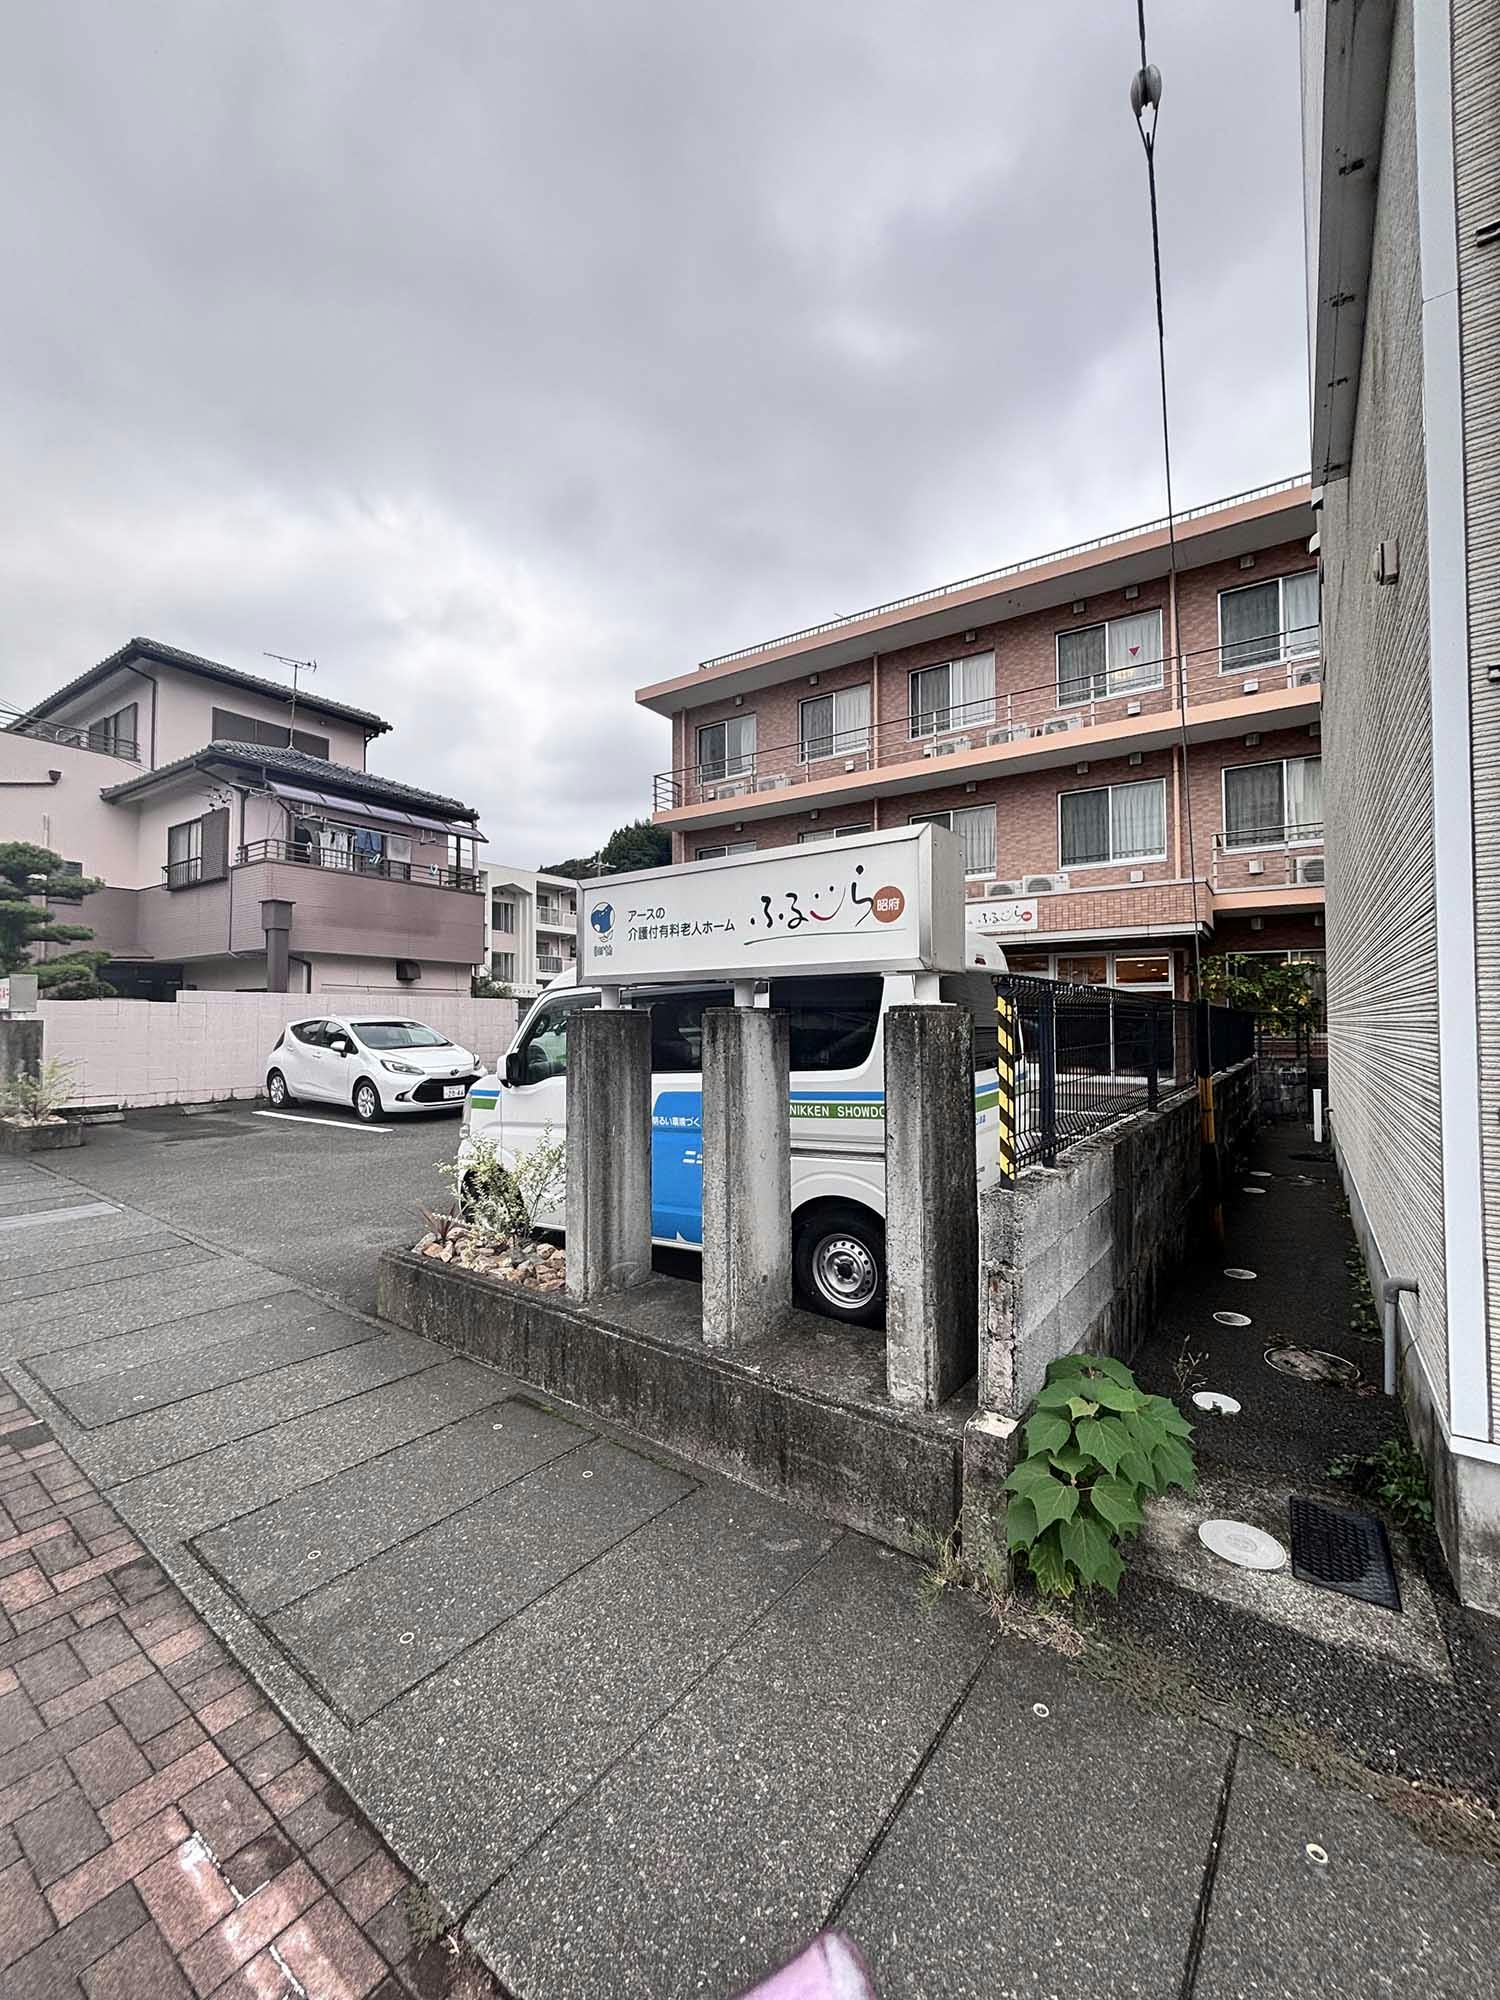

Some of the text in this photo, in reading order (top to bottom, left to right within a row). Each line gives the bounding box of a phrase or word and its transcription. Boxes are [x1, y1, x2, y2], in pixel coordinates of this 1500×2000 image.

[876, 897, 901, 912] 昭府
[627, 907, 666, 923] アースの
[627, 918, 736, 942] 介護付有料老人ホーム
[789, 1104, 830, 1117] NIKKEN
